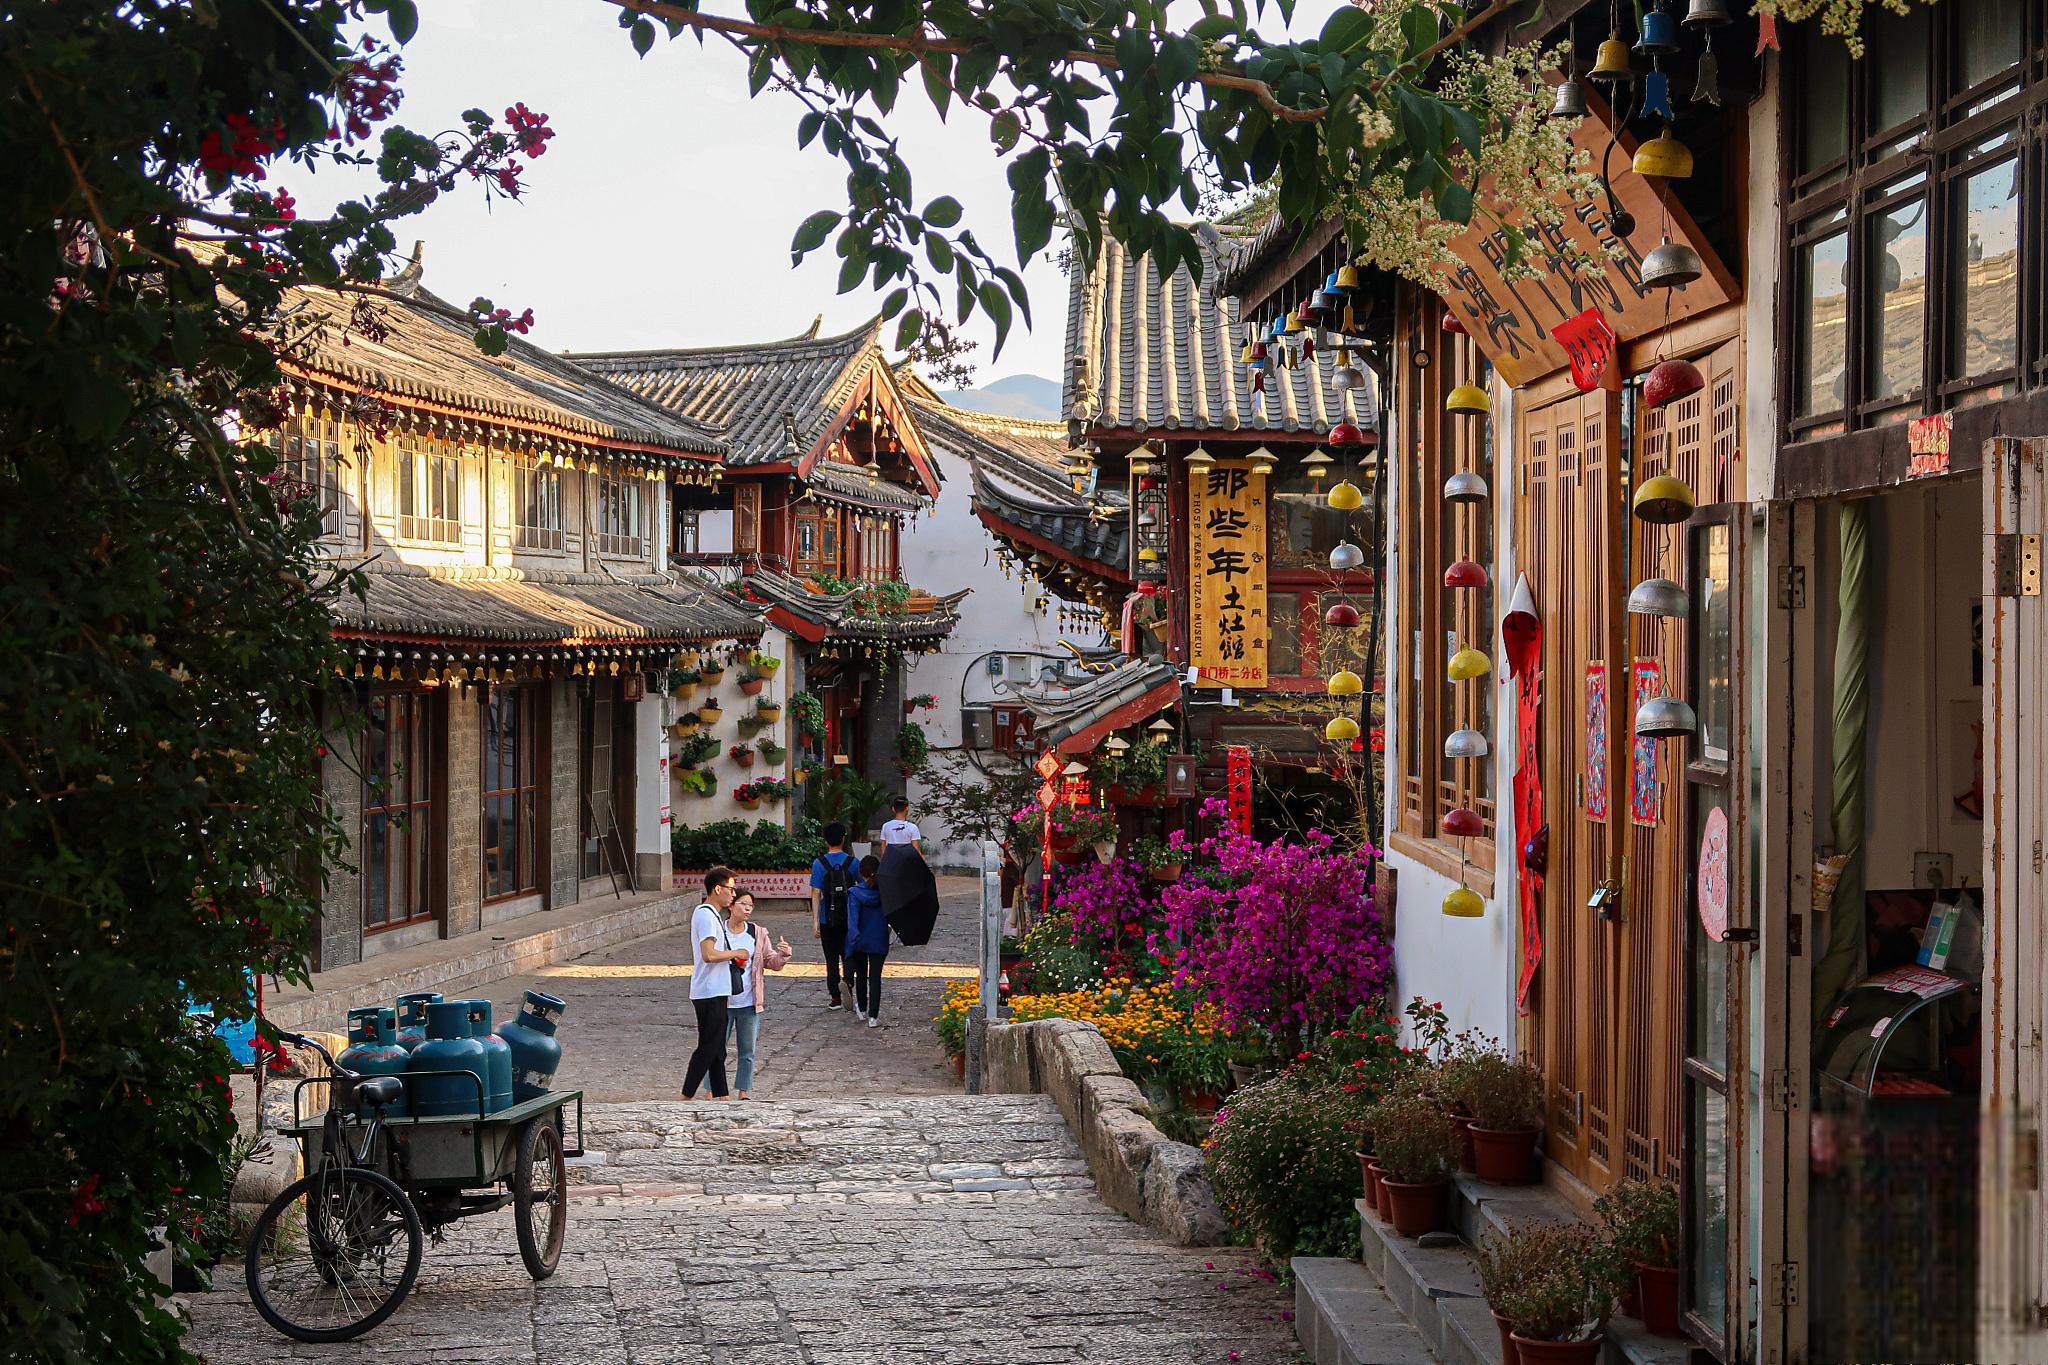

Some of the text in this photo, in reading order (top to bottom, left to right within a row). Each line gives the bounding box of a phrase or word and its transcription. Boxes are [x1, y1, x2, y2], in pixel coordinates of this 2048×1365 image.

[1193, 492, 1202, 658] THOSE YEARS TUZAO MUSEUM
